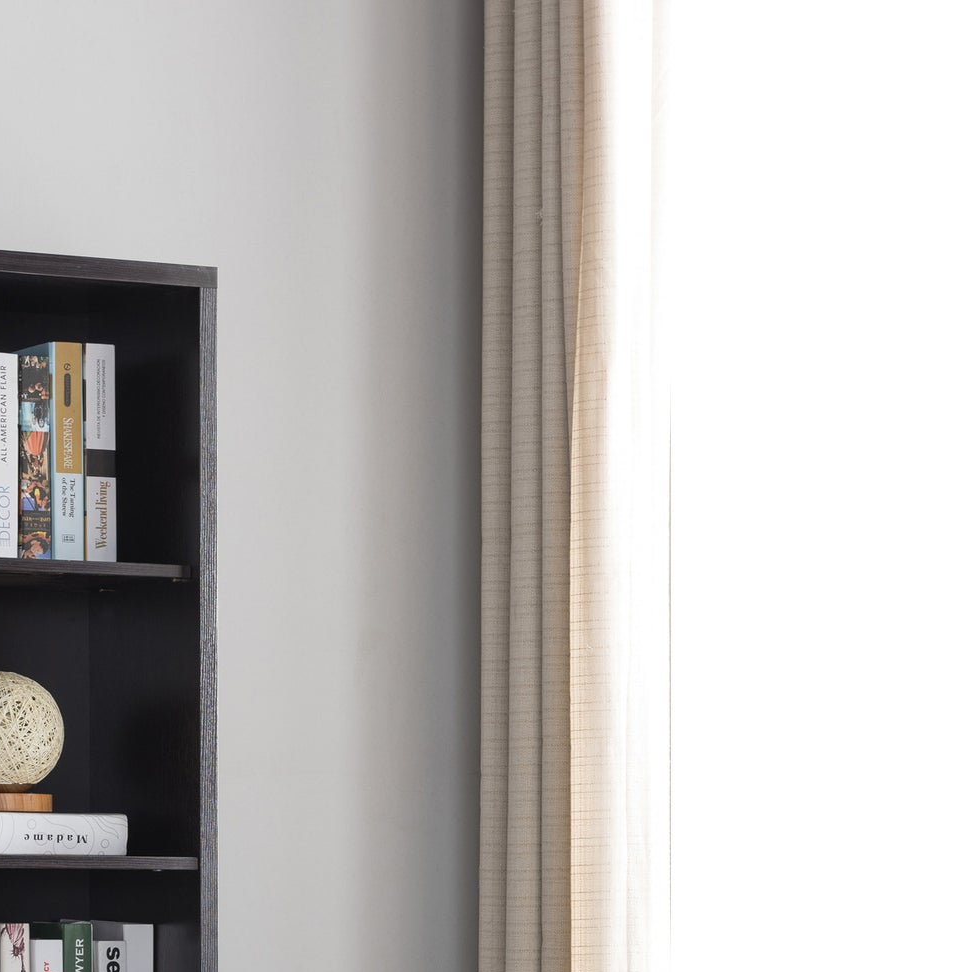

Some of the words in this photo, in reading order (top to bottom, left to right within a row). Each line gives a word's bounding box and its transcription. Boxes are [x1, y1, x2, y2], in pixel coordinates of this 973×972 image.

[62, 417, 74, 469] SHAKESPEARE
[68, 494, 76, 518] Taming
[95, 481, 111, 506] living
[95, 507, 107, 550] Weekend
[23, 833, 88, 844] Madame
